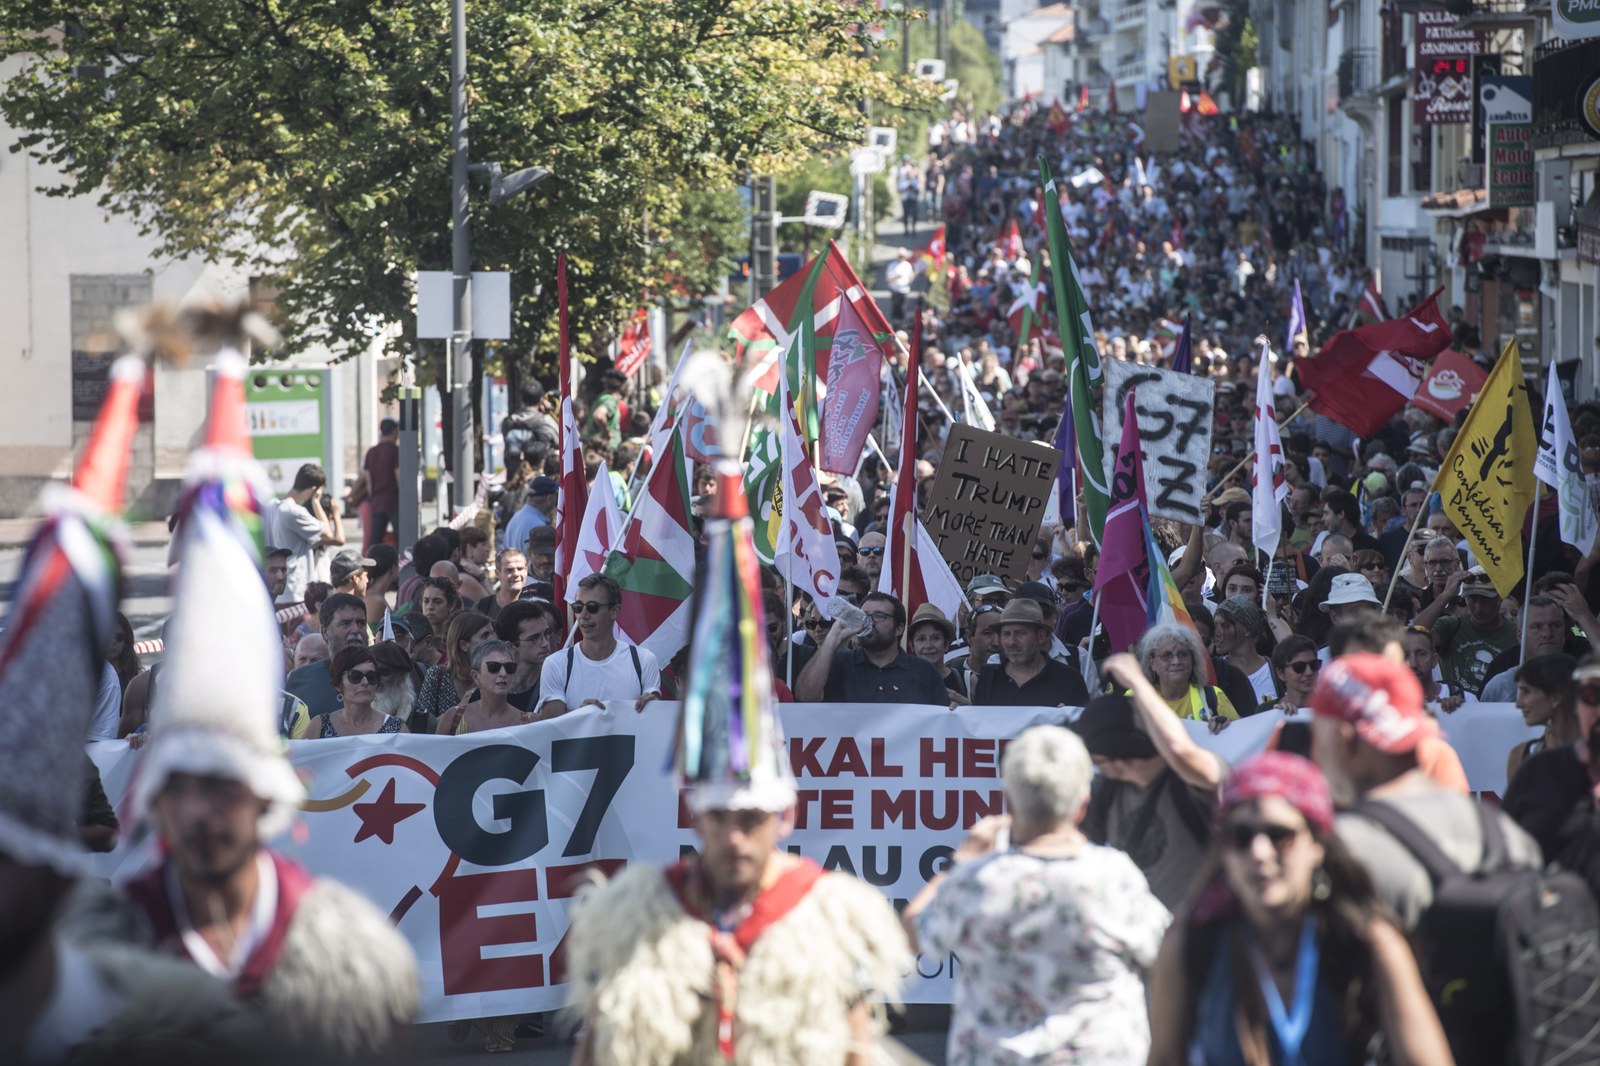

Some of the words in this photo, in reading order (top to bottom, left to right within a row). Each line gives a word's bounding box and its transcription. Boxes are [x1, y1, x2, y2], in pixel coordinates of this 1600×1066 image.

[1496, 127, 1530, 141] Auto
[1494, 148, 1531, 163] Moto
[1116, 373, 1210, 454] G7
[954, 438, 974, 463] I
[982, 446, 1052, 480] HATE
[952, 472, 1042, 515] TRUMP
[926, 504, 987, 536] MORE
[989, 520, 1034, 546] THAN
[963, 539, 1014, 568] HATE
[433, 735, 636, 866] G7
[871, 789, 1004, 830] MUN
